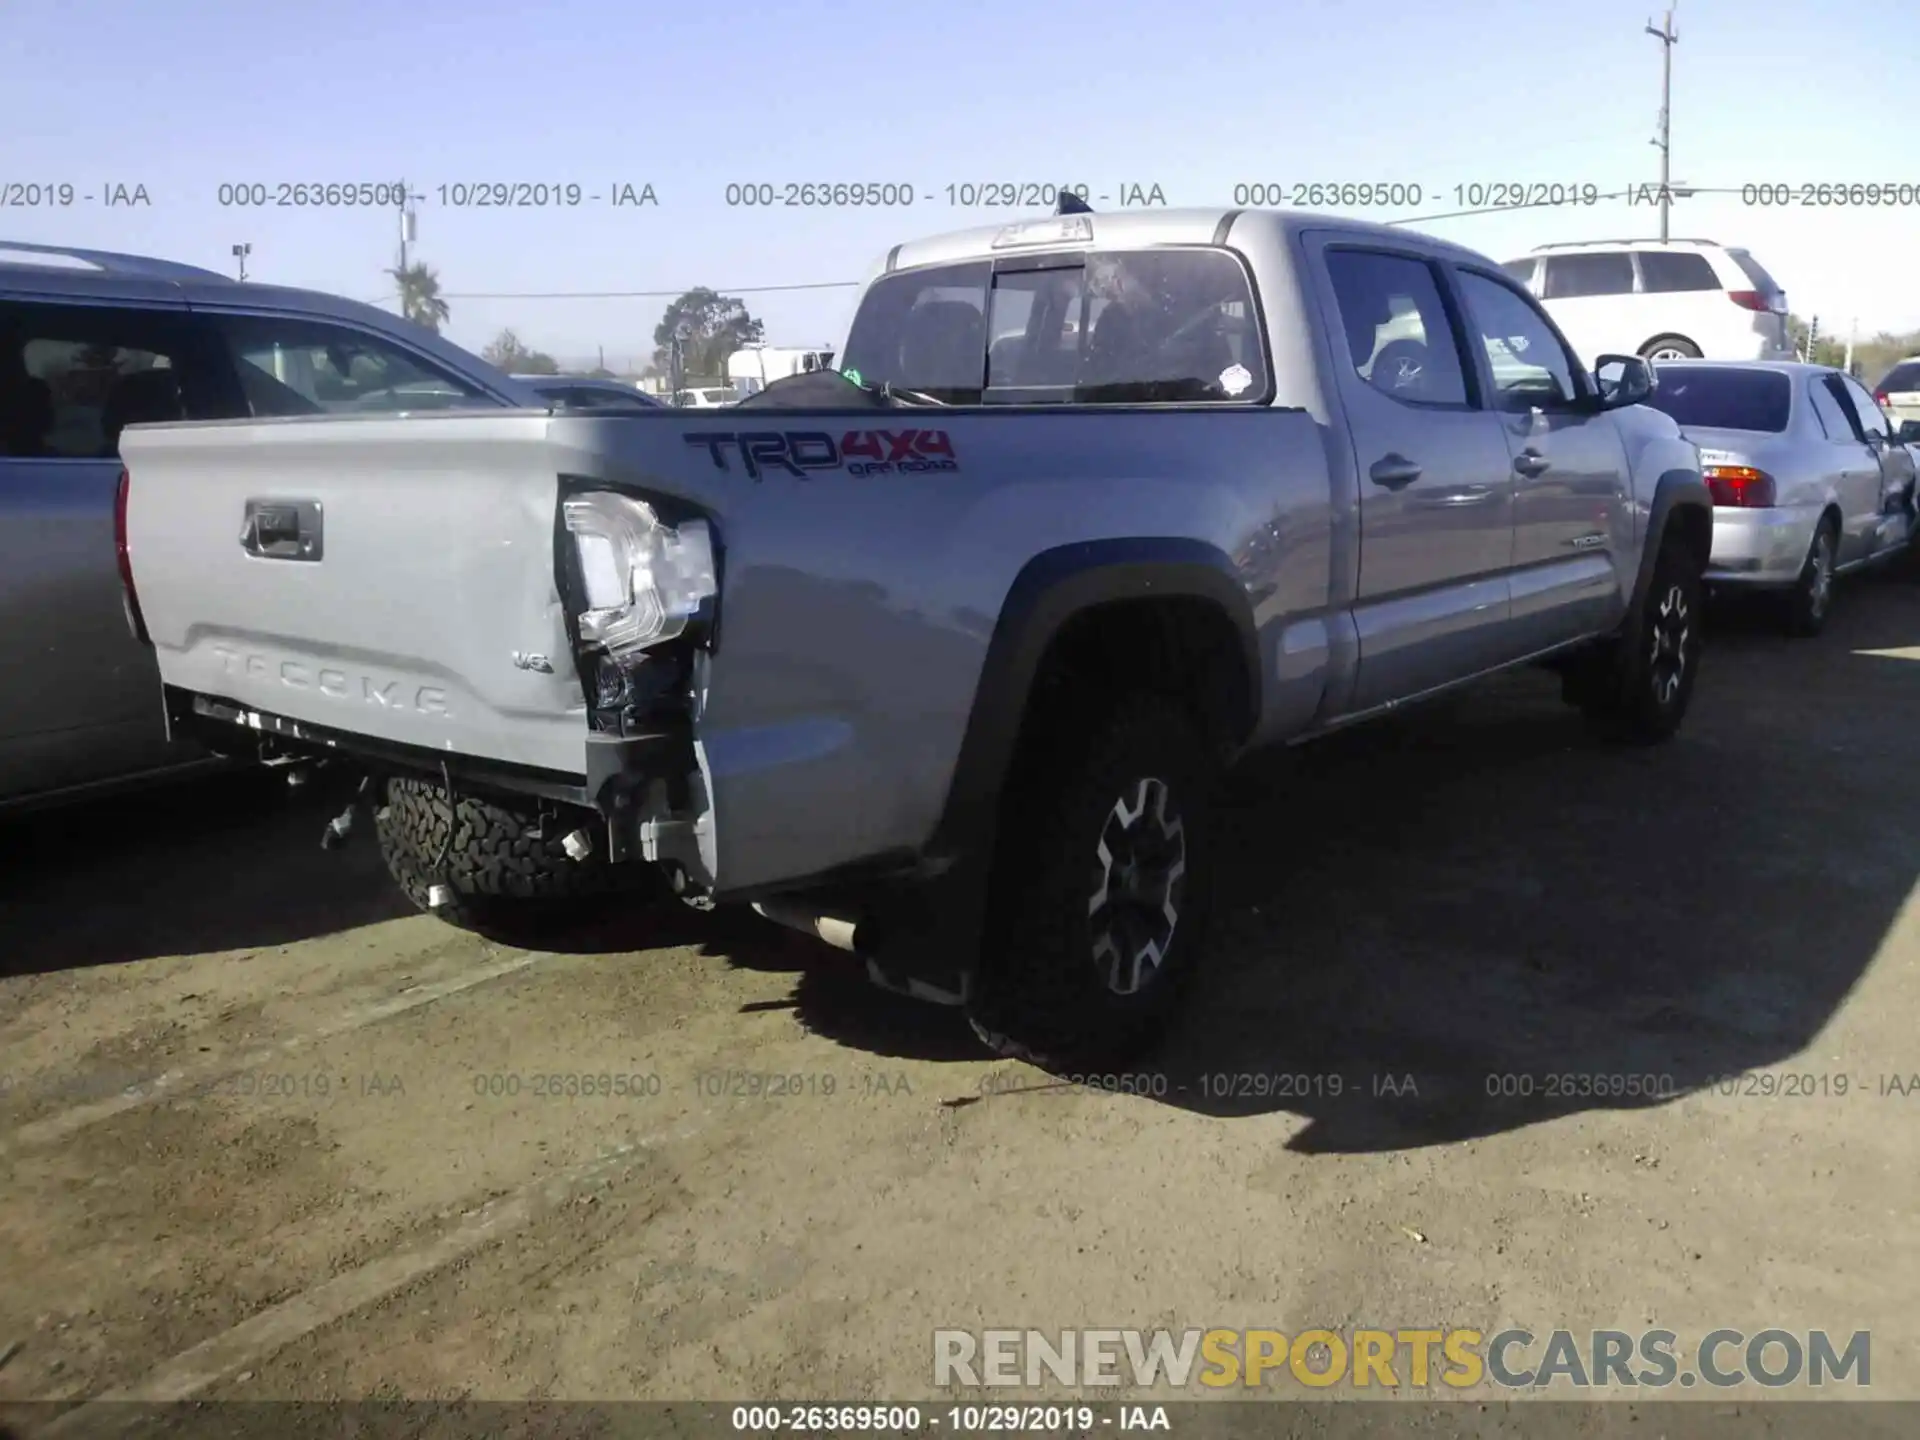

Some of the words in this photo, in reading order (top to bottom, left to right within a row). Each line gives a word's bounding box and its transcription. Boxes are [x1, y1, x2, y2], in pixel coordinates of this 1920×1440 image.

[682, 431, 840, 482] TRD
[848, 461, 893, 476] OFF
[896, 459, 958, 474] ROAD
